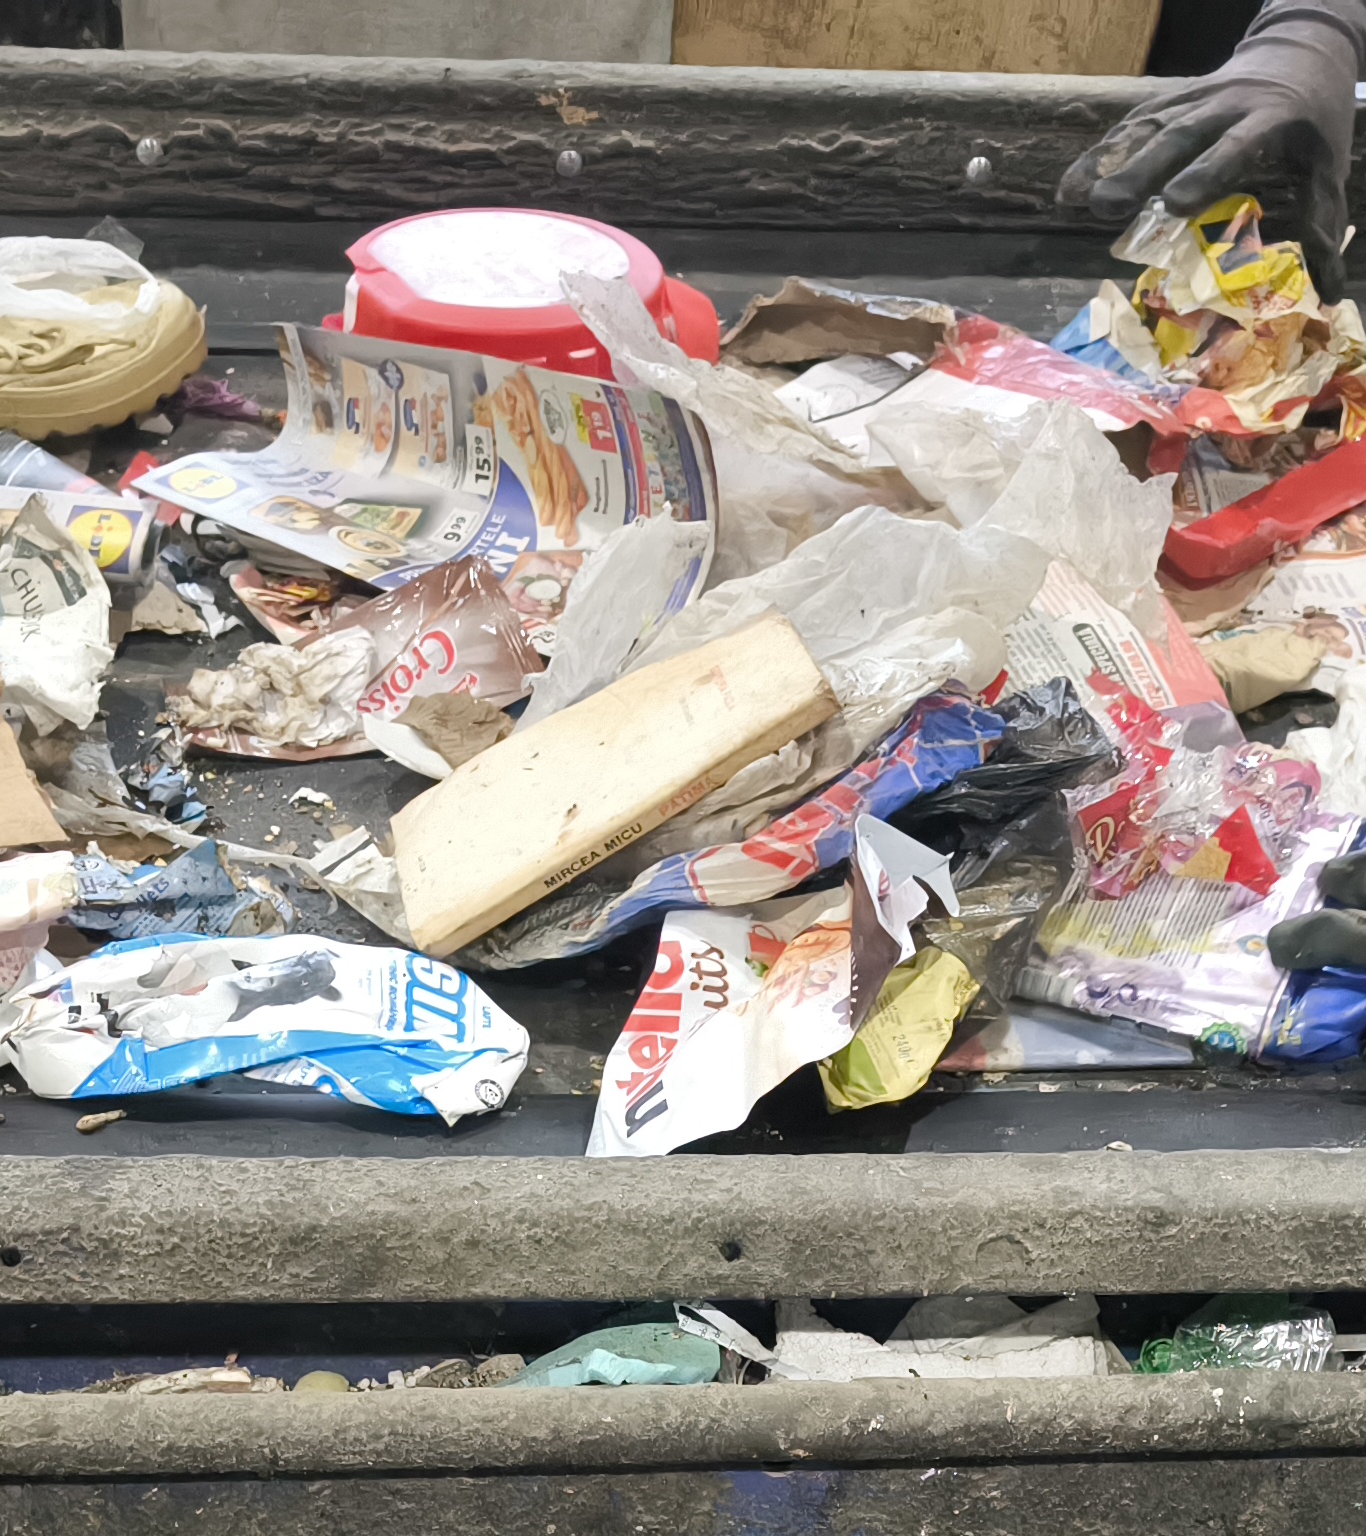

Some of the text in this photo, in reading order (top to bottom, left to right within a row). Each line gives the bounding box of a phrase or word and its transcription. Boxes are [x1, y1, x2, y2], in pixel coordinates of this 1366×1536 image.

[658, 774, 720, 818] PATIMA
[543, 822, 644, 889] MIRCEA MICU
